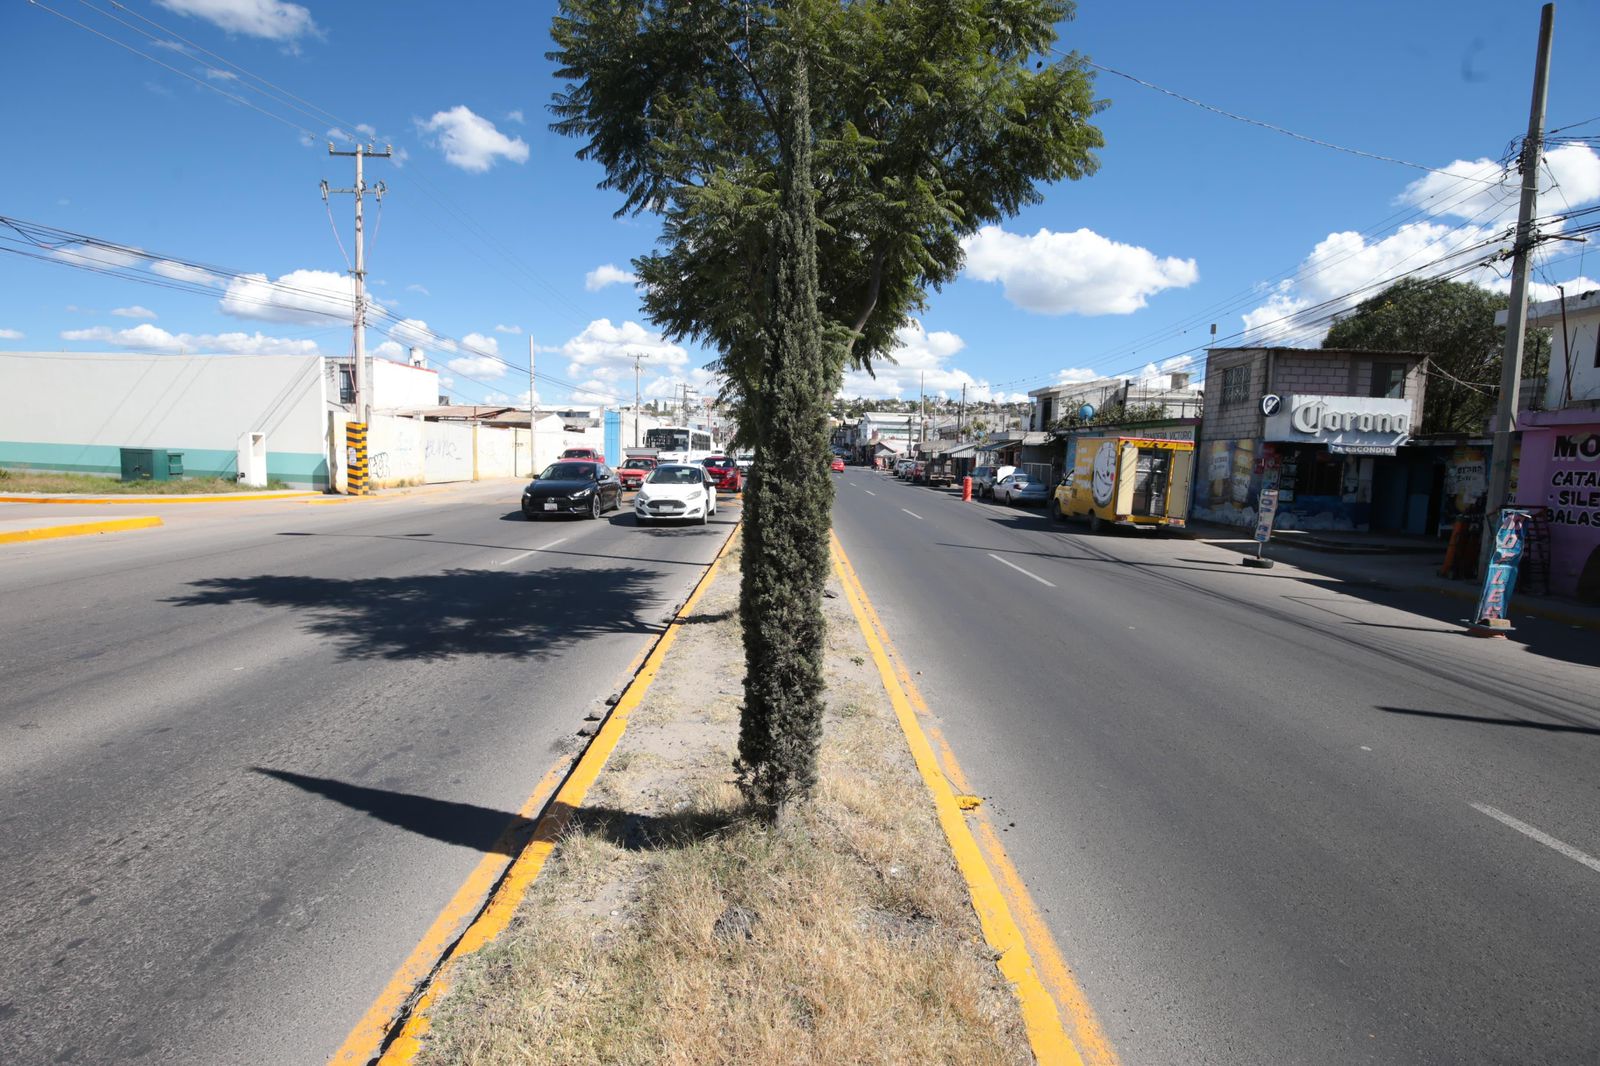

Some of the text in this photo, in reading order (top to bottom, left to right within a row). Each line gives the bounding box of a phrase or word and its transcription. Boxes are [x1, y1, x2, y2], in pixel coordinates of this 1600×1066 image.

[1291, 400, 1408, 438] Corona
[1345, 446, 1396, 455] ESCONDIDA
[1551, 470, 1600, 487] CATA
